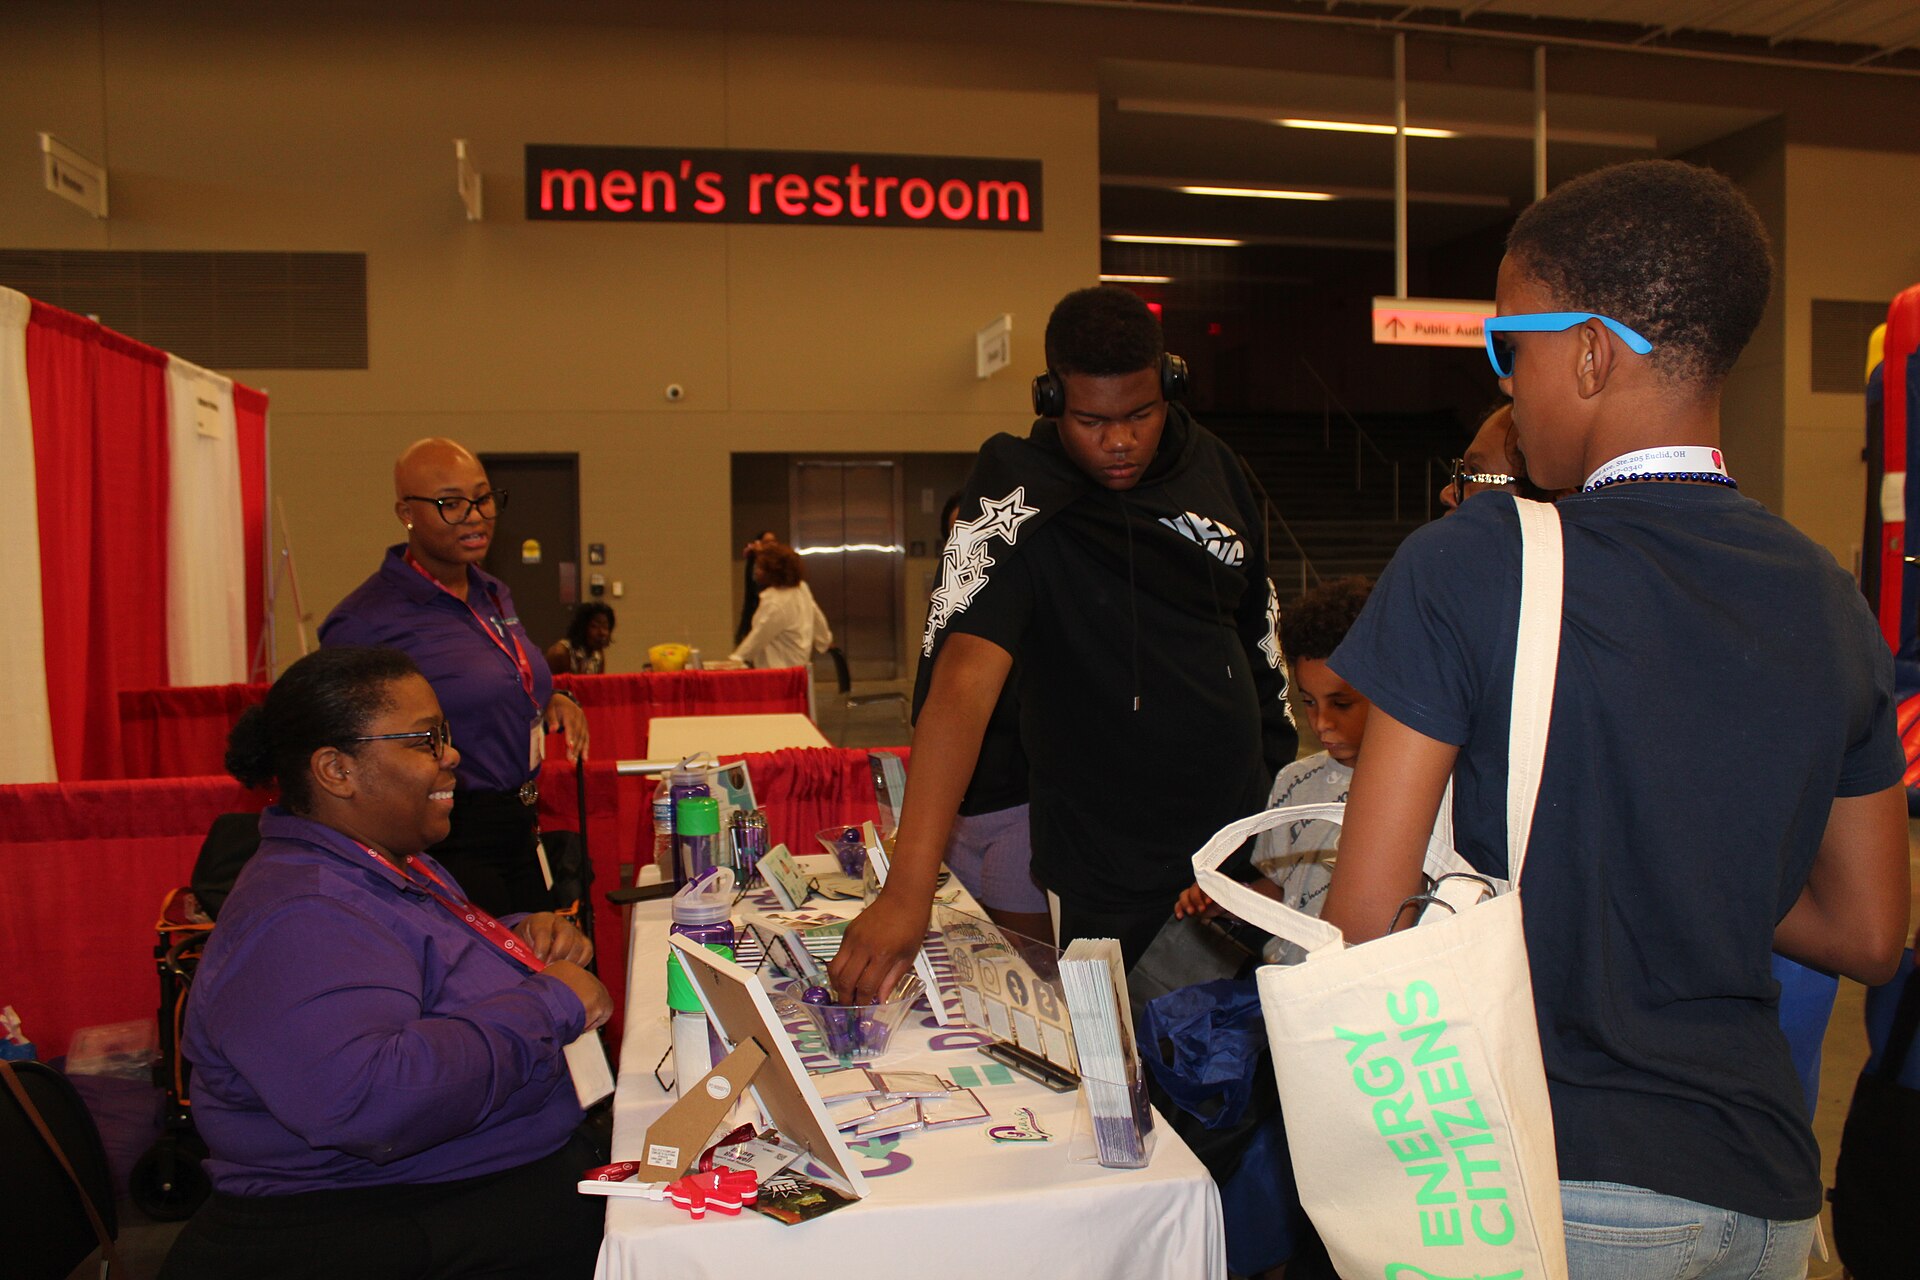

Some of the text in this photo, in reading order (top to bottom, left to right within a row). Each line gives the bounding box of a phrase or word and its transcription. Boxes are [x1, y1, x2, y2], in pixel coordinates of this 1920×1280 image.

[540, 159, 1031, 223] men's restroom
[1414, 322, 1484, 337] Public Audi
[1645, 452, 1672, 460] Euclid,
[1673, 450, 1686, 458] OH
[1334, 1025, 1464, 1247] ENERGY
[1385, 980, 1516, 1247] CITIZENS
